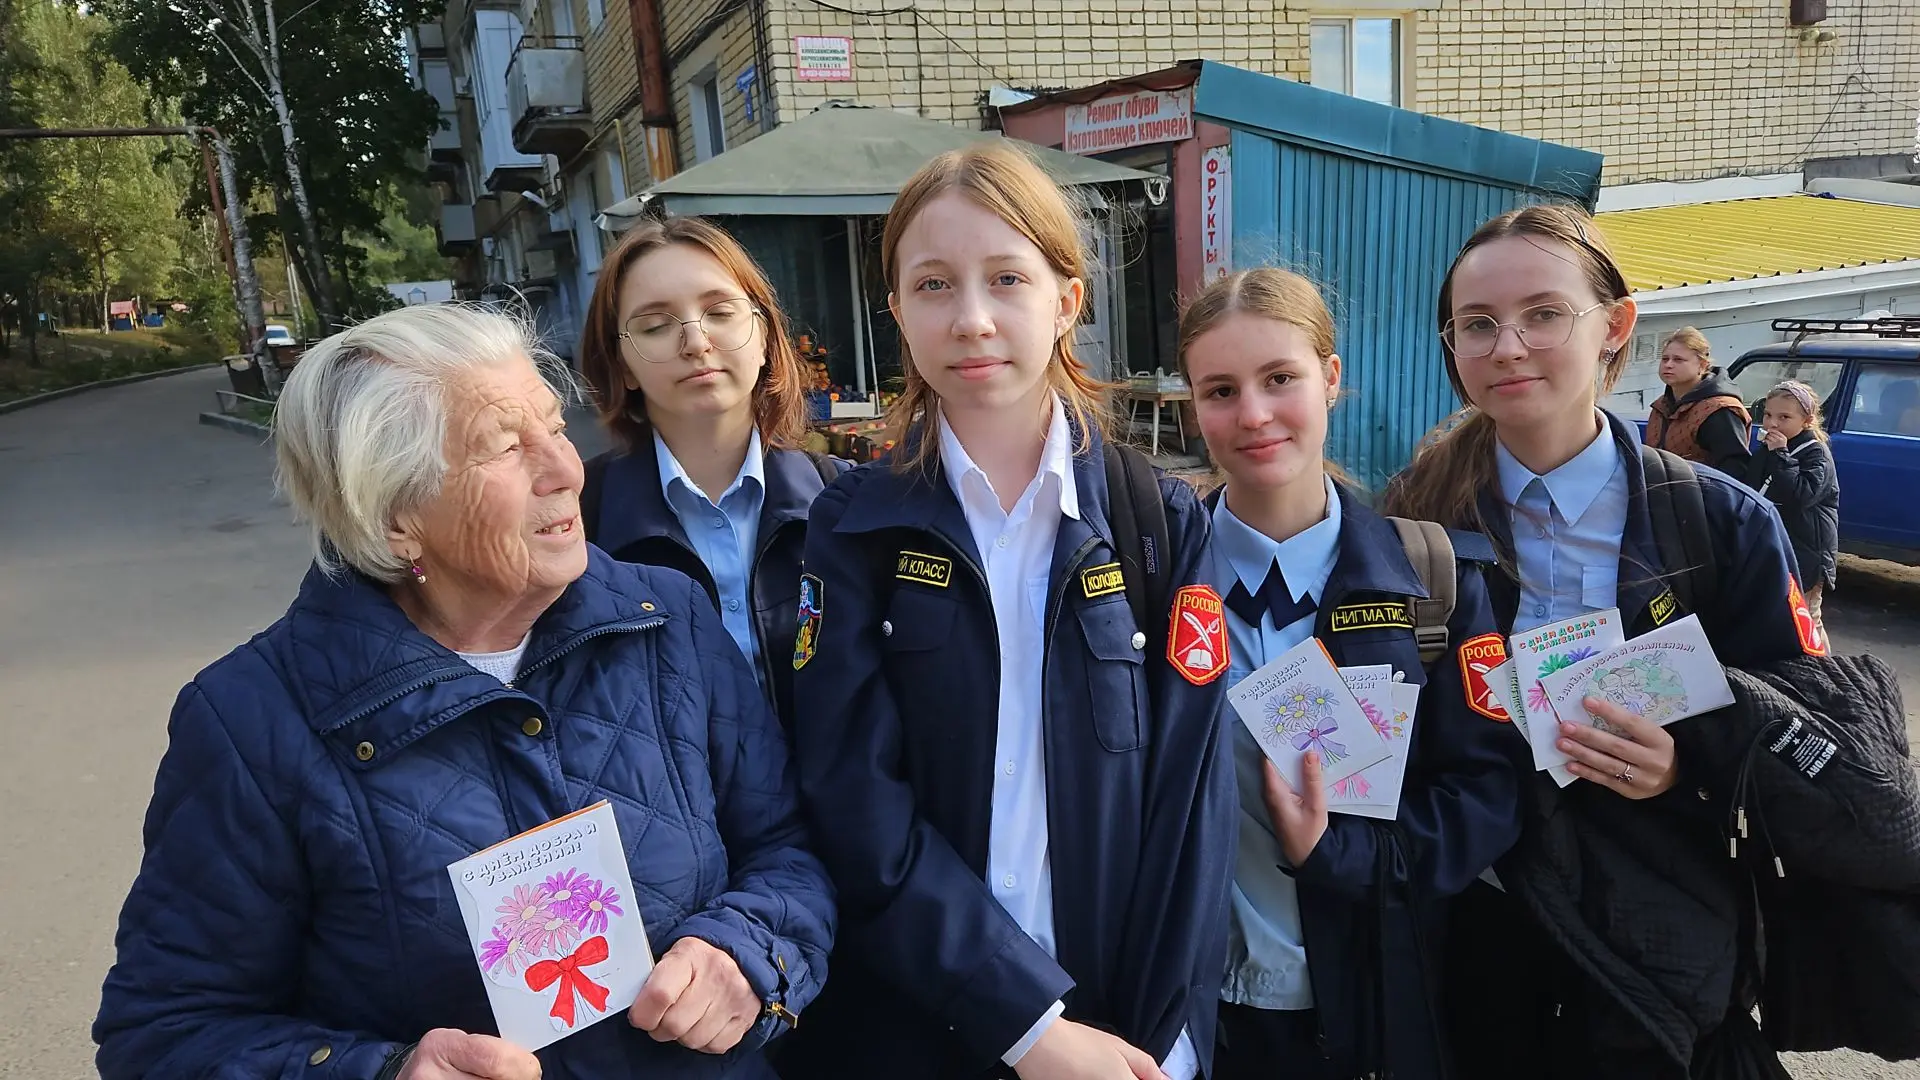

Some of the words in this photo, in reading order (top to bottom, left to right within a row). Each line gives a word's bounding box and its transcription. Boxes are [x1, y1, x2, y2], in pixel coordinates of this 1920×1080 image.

[1086, 102, 1123, 125] Ремонт
[1125, 95, 1158, 119] обуви
[1067, 123, 1136, 151] Изготовление
[1138, 112, 1188, 140] ключей
[1206, 159, 1218, 263] ФРУКТЫ
[909, 560, 945, 579] КЛАСС
[1181, 594, 1220, 614] РОССИЯ
[1528, 631, 1556, 647] ДНЁМ
[1559, 620, 1596, 637] ДОБРА
[464, 871, 475, 882] С
[479, 850, 524, 878] ДНЁМ
[530, 829, 583, 858] ДОБРА
[585, 823, 597, 835] И
